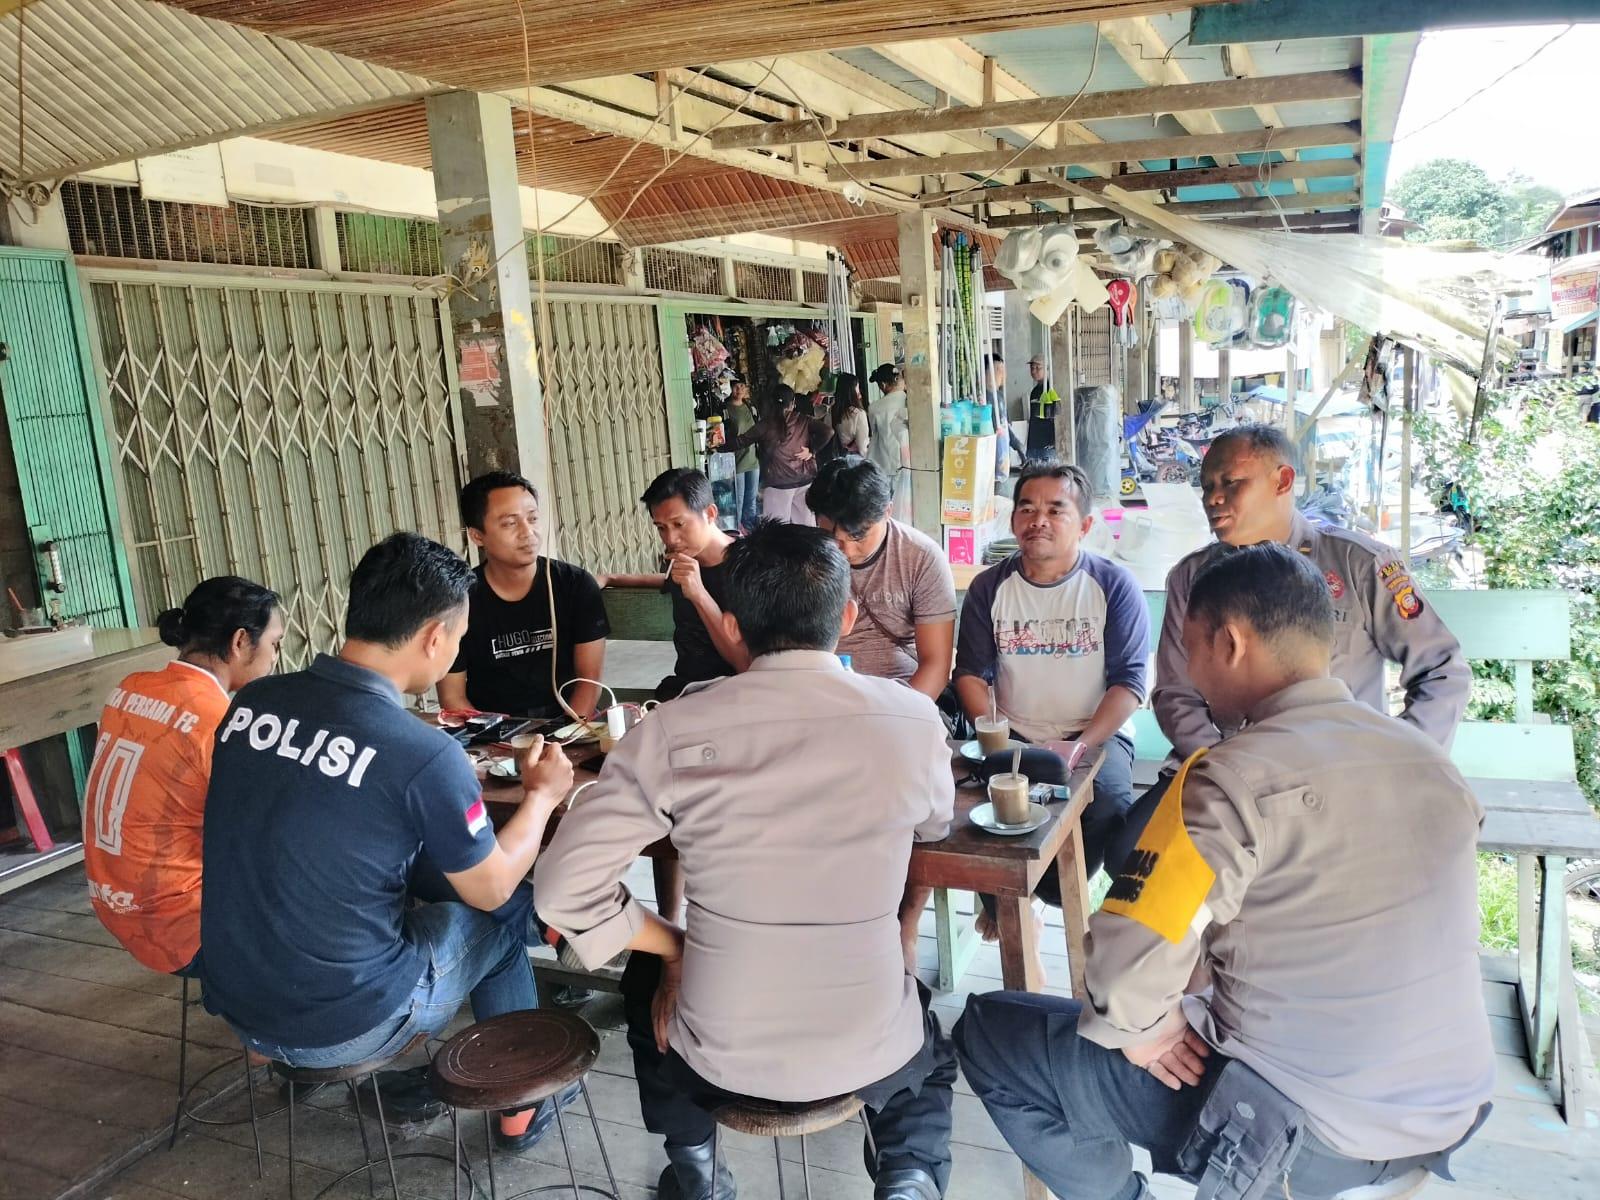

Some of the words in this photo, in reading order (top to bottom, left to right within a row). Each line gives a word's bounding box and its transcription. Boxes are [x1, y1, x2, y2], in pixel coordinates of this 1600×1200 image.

[498, 629, 530, 648] HUGO
[122, 692, 176, 725] PERSADA
[173, 710, 200, 734] FC
[221, 707, 377, 787] POLISI
